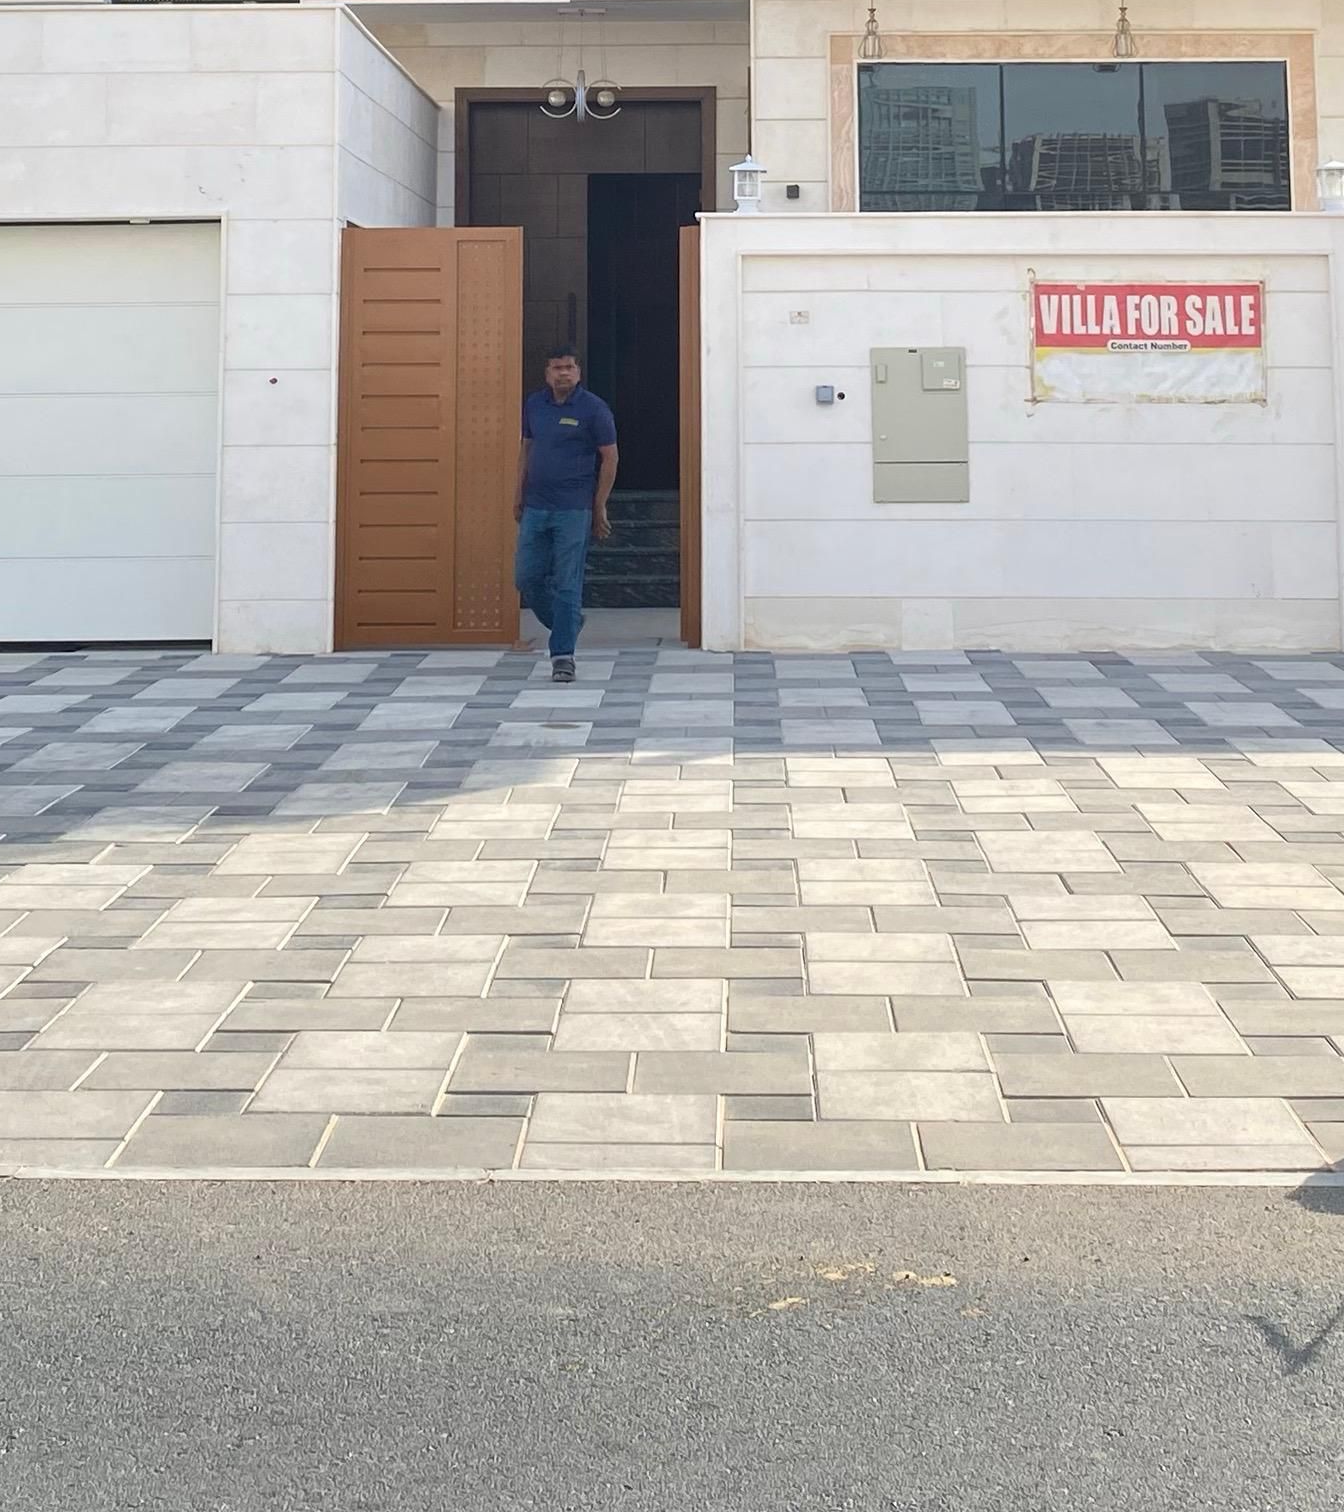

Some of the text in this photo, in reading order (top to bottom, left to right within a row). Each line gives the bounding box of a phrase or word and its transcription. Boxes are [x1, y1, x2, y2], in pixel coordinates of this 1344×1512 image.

[1039, 294, 1256, 336] VILLA FOR SALE
[1110, 342, 1188, 350] Contact Number
